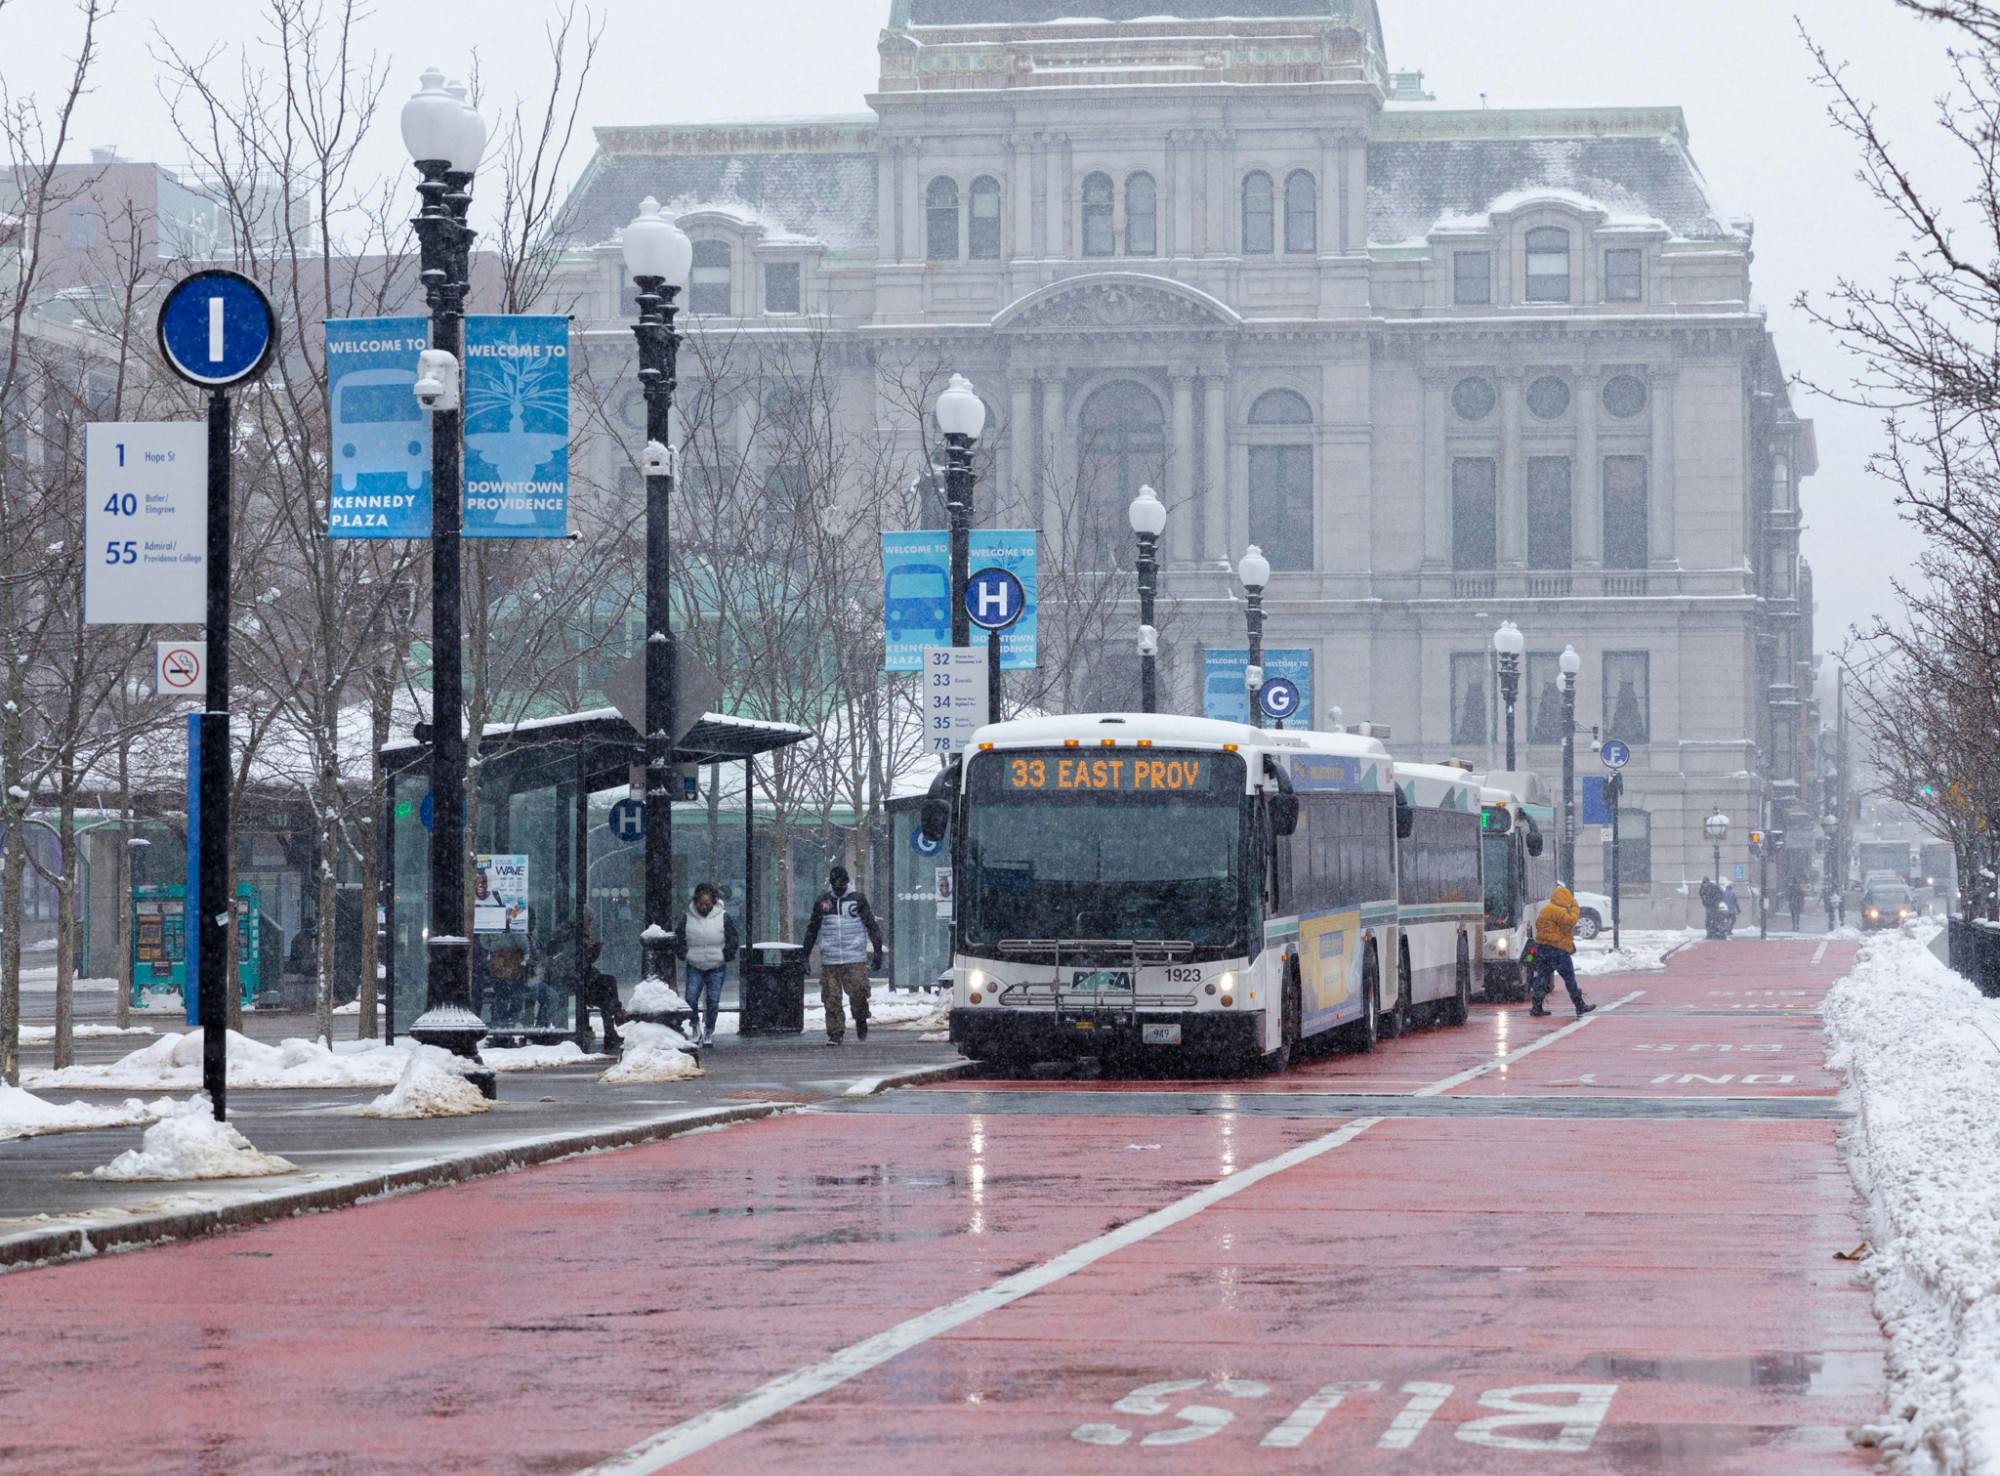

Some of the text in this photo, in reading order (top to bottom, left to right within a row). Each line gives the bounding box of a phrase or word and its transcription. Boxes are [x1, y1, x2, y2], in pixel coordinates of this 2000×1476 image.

[329, 338, 426, 354] WELCOME TO
[467, 344, 566, 358] WELCOME TO
[115, 443, 125, 467] 1
[145, 450, 176, 463] Hope St
[468, 481, 564, 494] DOWNTOWN
[104, 492, 137, 516] 40
[332, 494, 416, 509] KENNEDY
[467, 498, 564, 511] PROVIDENCE
[145, 505, 176, 516] Elmgrove
[331, 514, 388, 528] PLAZA
[144, 541, 177, 551] Admiral/
[885, 544, 948, 554] WELCOME TO
[105, 541, 138, 565] 55
[143, 553, 202, 564] Providence College
[971, 548, 1035, 558] WELCOME TO
[978, 582, 1008, 617] H
[973, 634, 1034, 643] DONTOWN
[886, 656, 922, 665] PLAZA
[933, 653, 950, 665] 32
[933, 674, 950, 686] 33
[933, 696, 951, 708] 34
[1267, 686, 1290, 711] G
[933, 717, 951, 729] 35
[933, 737, 950, 750] 78
[1610, 746, 1621, 763] F
[1010, 759, 1199, 789] 33 EAST PROV
[619, 806, 642, 833] H
[495, 865, 526, 876] WAVE
[1165, 968, 1202, 983] 1923
[1636, 1044, 1783, 1052] BUS
[1070, 1378, 1619, 1452] BUS
